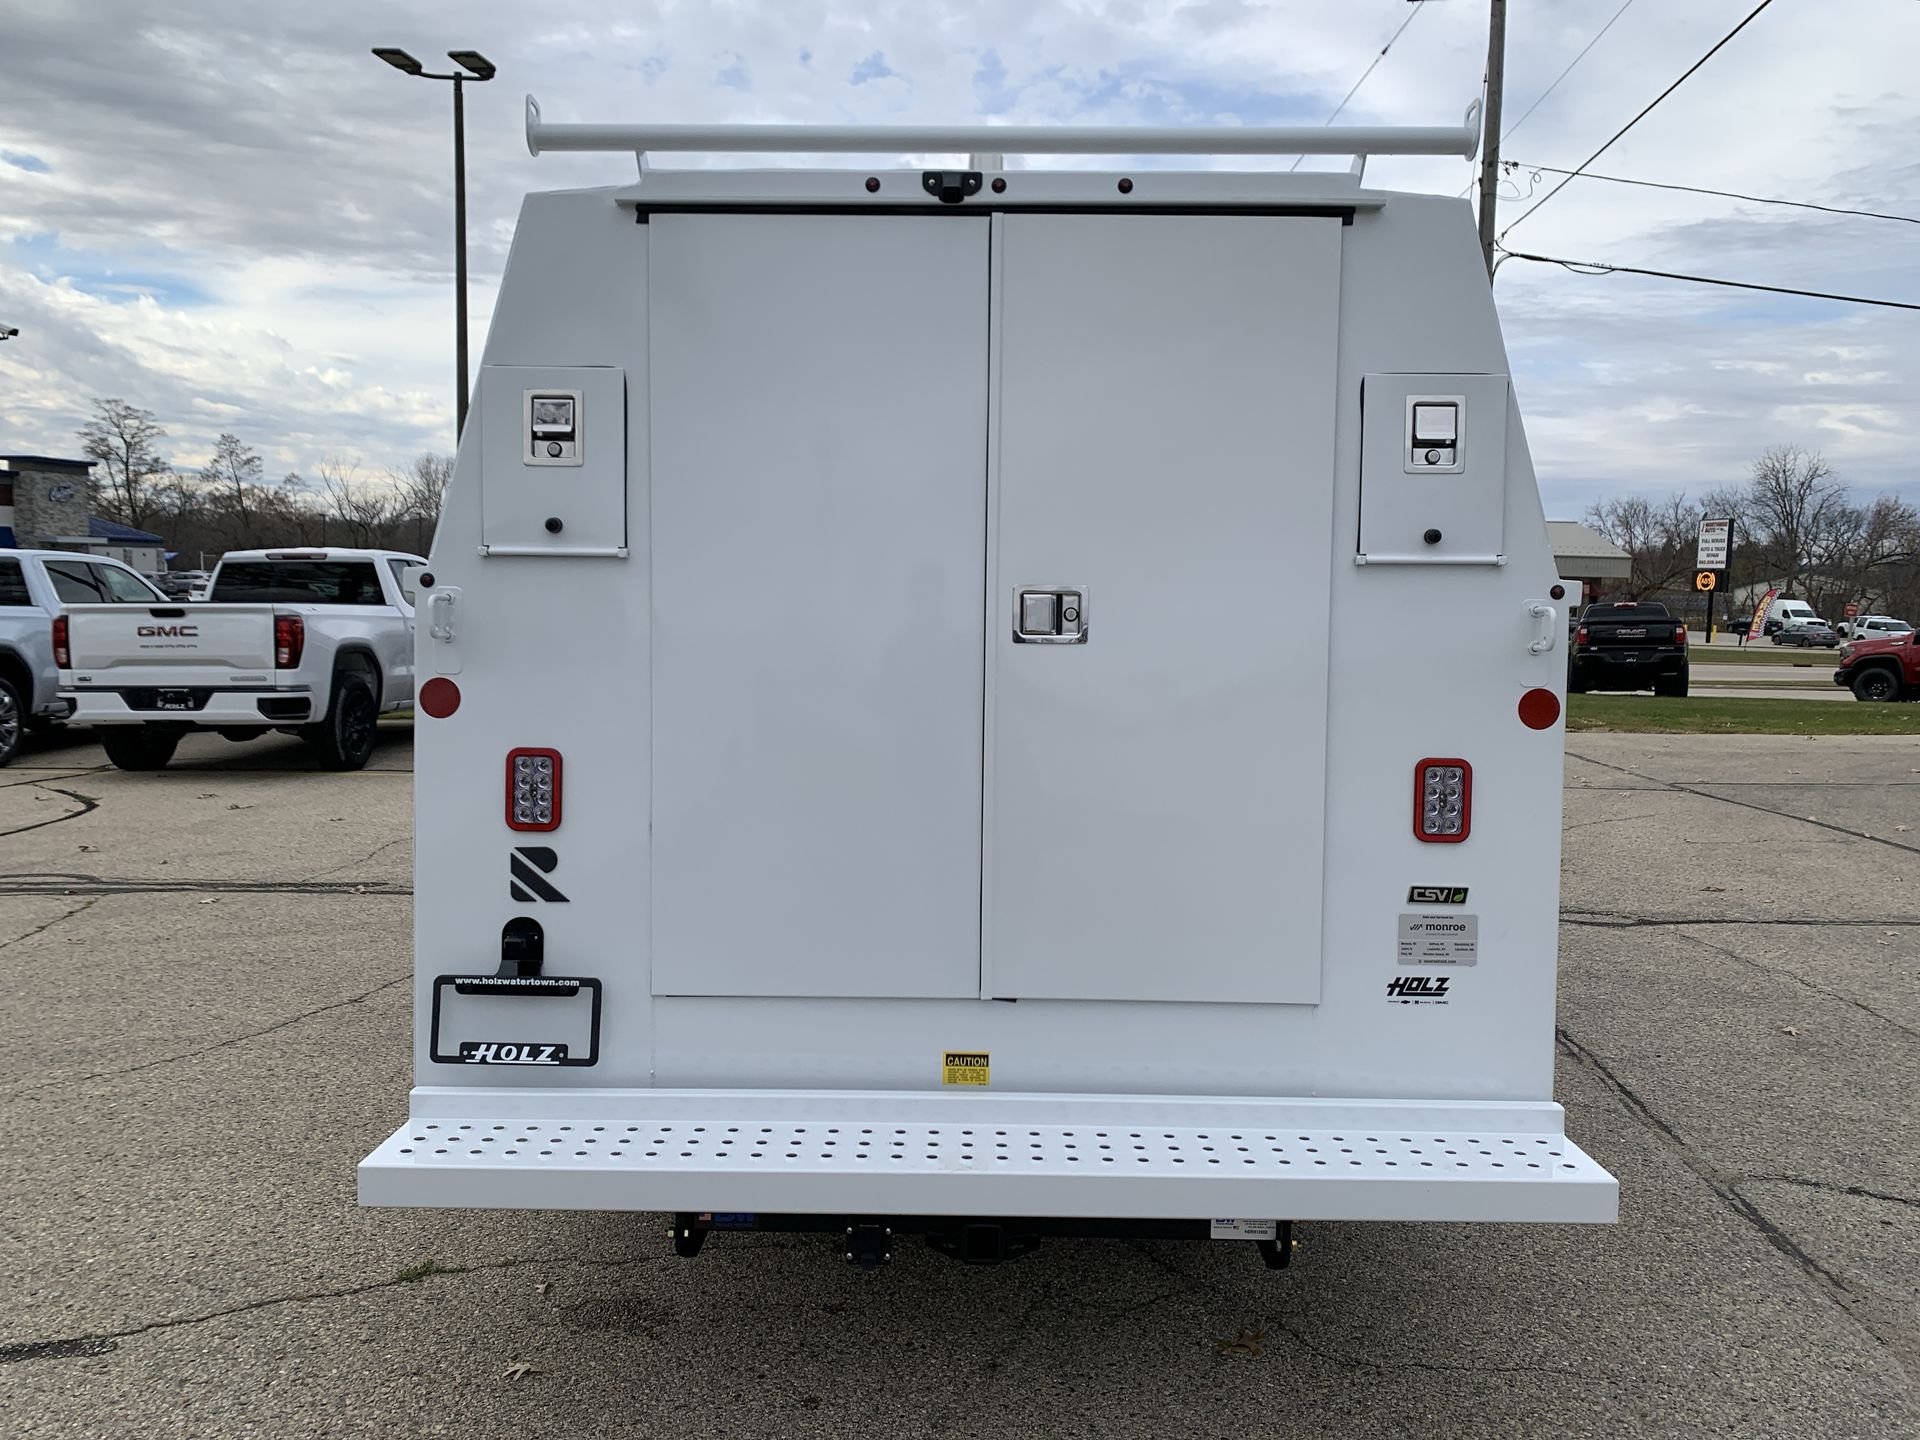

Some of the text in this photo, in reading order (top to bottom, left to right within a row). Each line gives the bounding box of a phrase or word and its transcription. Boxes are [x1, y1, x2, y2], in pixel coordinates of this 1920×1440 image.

[137, 625, 199, 637] GMC
[1413, 888, 1449, 902] CSV
[1425, 923, 1466, 931] monroe
[454, 976, 580, 987] www.holzwatertown.com
[1386, 976, 1450, 997] HOLZ
[466, 1043, 560, 1065] HOLZ
[947, 1056, 987, 1067] CAUTION
